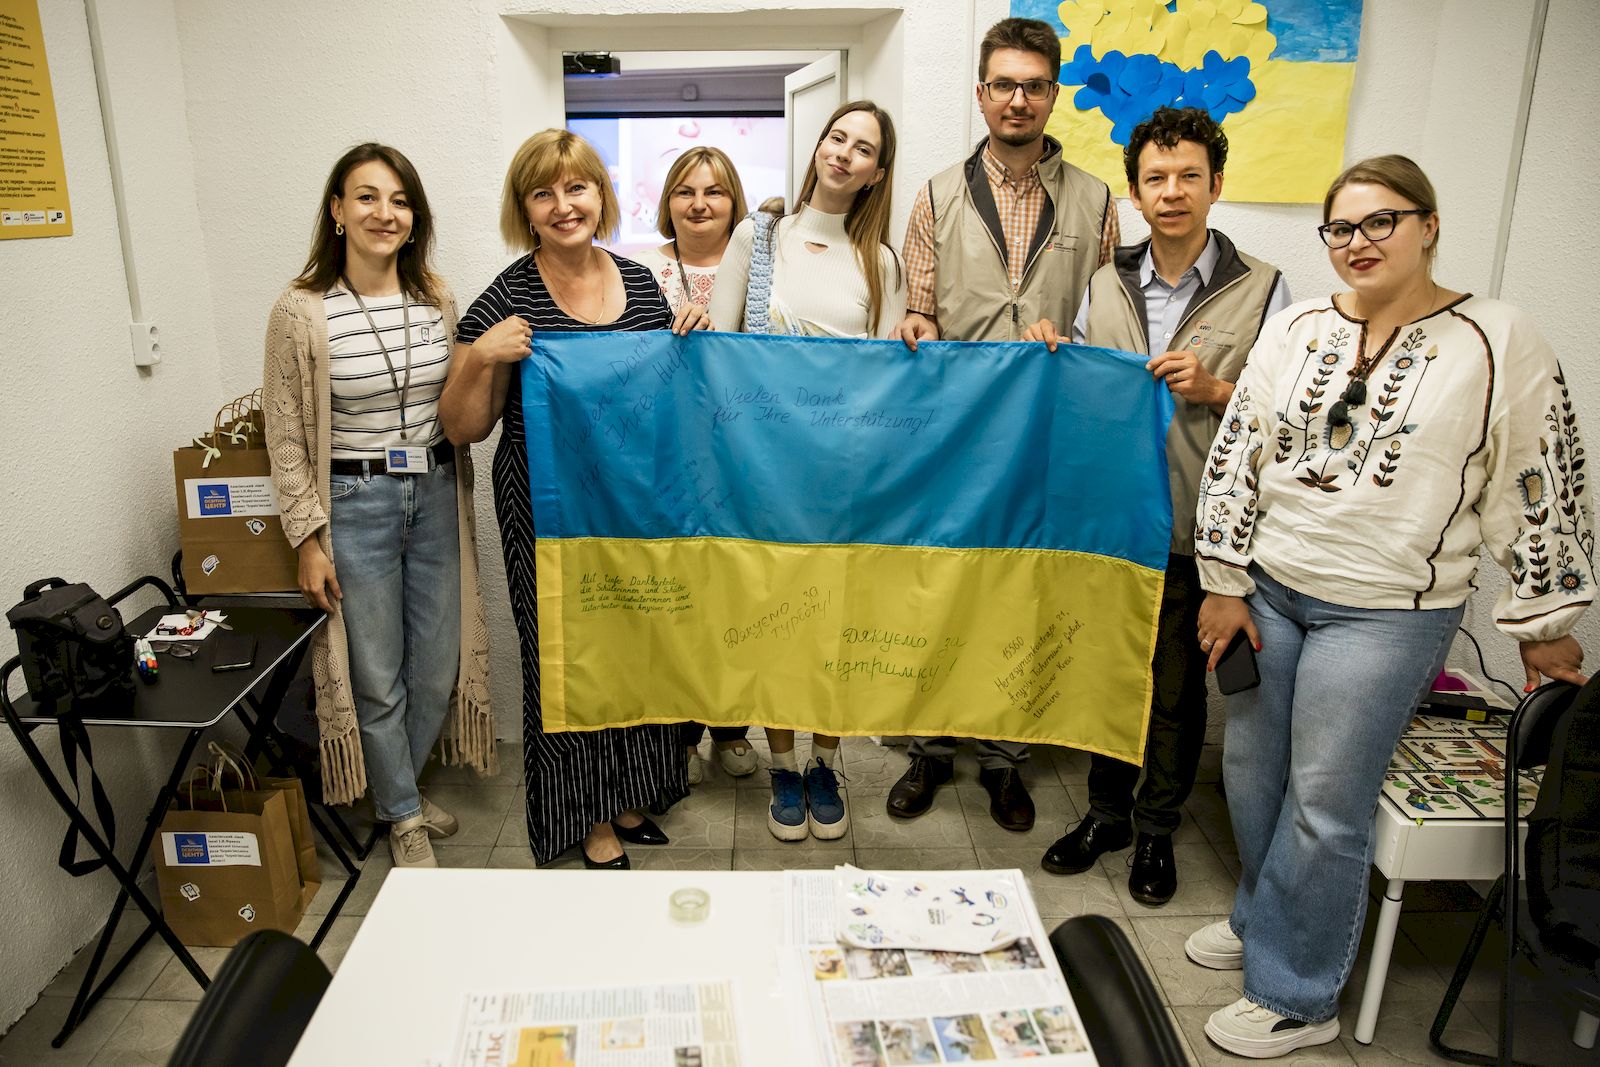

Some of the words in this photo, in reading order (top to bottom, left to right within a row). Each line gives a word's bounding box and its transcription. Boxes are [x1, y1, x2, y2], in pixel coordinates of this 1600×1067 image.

[562, 392, 612, 454] Vielen
[608, 336, 652, 387] Dank
[725, 384, 781, 405] Vielen
[793, 386, 846, 407] Dank
[605, 394, 652, 449] Ihre
[712, 405, 743, 432] für
[754, 406, 791, 424] Ihre
[810, 409, 935, 435] Unterstützung!
[723, 602, 790, 649] Дякуємо
[803, 586, 819, 602] за
[842, 627, 927, 653] Дякуємо
[1002, 635, 1025, 660] 15560
